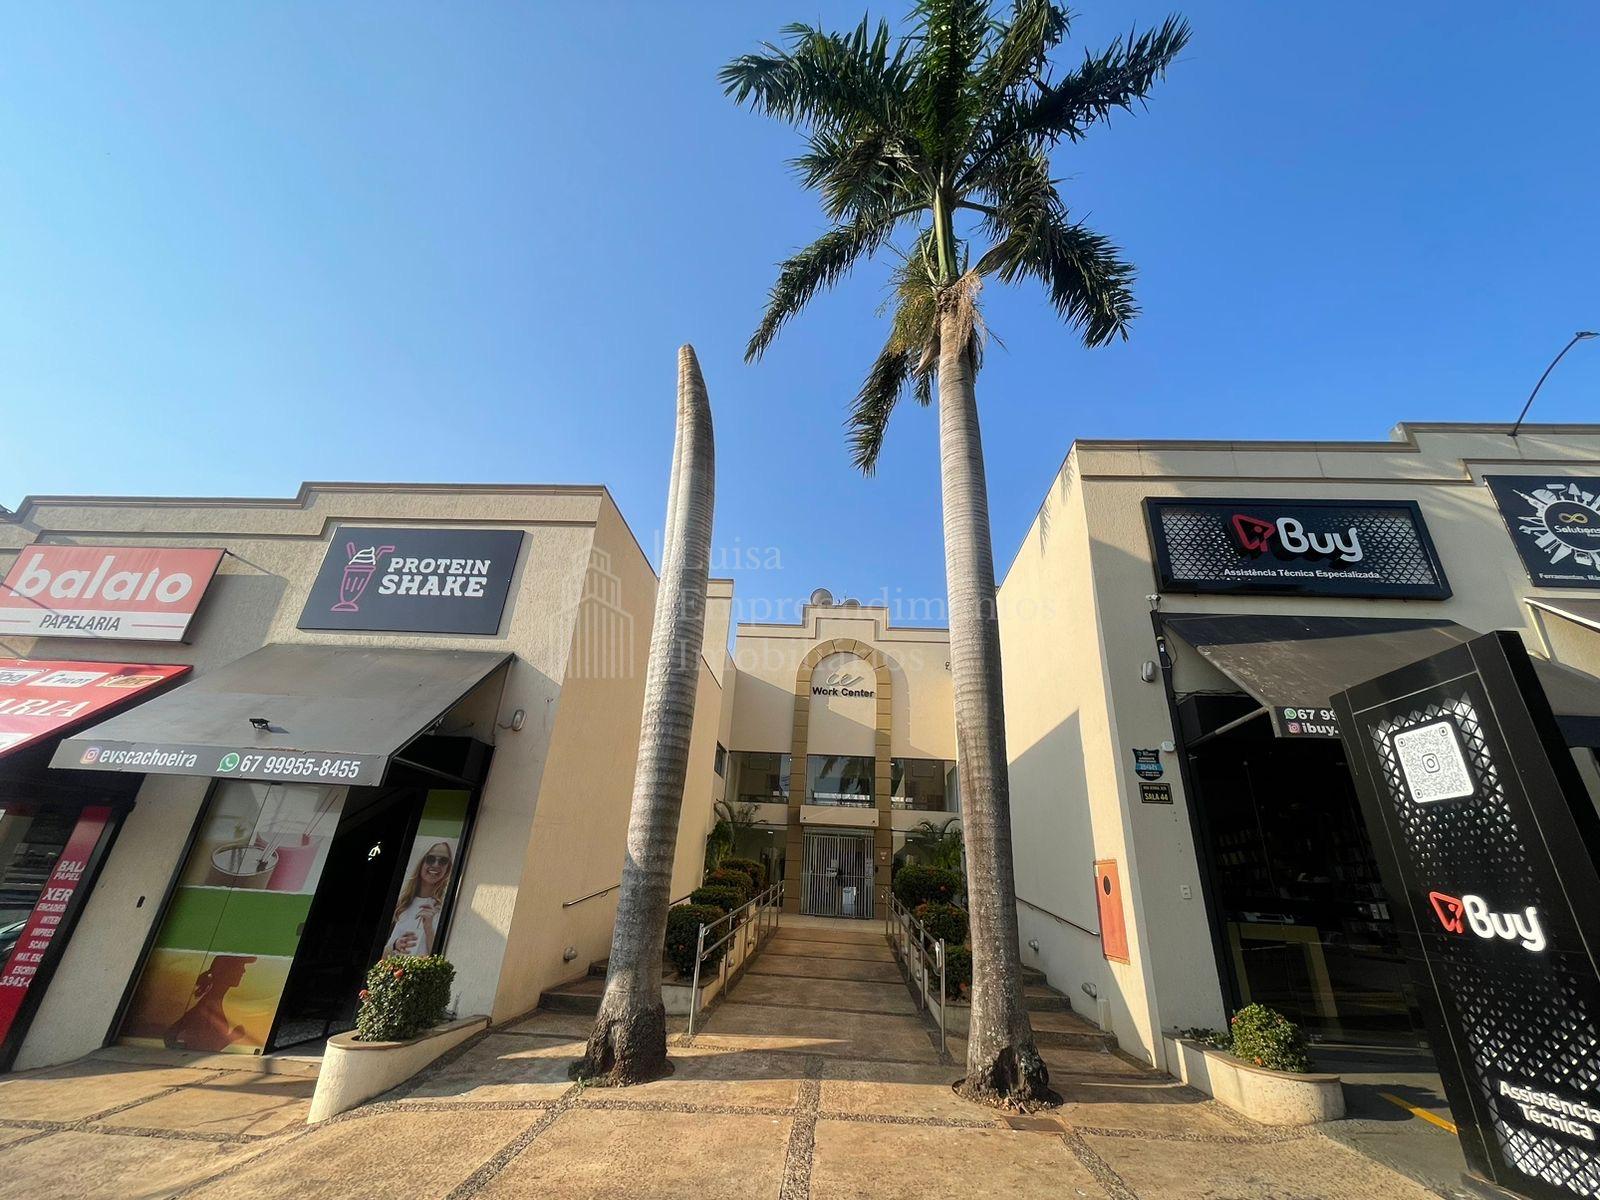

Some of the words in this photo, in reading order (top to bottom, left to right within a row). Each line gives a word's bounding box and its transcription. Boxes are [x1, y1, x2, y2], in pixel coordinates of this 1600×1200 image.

[387, 557, 491, 575] PROTEIN
[1224, 568, 1277, 577] Assistência
[1278, 569, 1315, 578] Técnica
[1315, 570, 1381, 580] Especializada
[378, 574, 488, 597] SHAKE
[38, 614, 122, 632] PAPELARIA
[812, 686, 839, 697] Work
[841, 687, 875, 698] Center
[1297, 709, 1315, 720] 67
[1302, 722, 1339, 737] ibuy.
[99, 748, 198, 768] evscachoeira
[240, 755, 262, 773] 67
[264, 756, 361, 779] 99955-8455
[1144, 793, 1160, 801] SALA
[58, 861, 87, 872] BAL
[1462, 894, 1547, 952] Buy
[0, 976, 32, 987] 3341-
[1499, 1080, 1600, 1124] Assistência
[1517, 1102, 1596, 1141] Técnica
